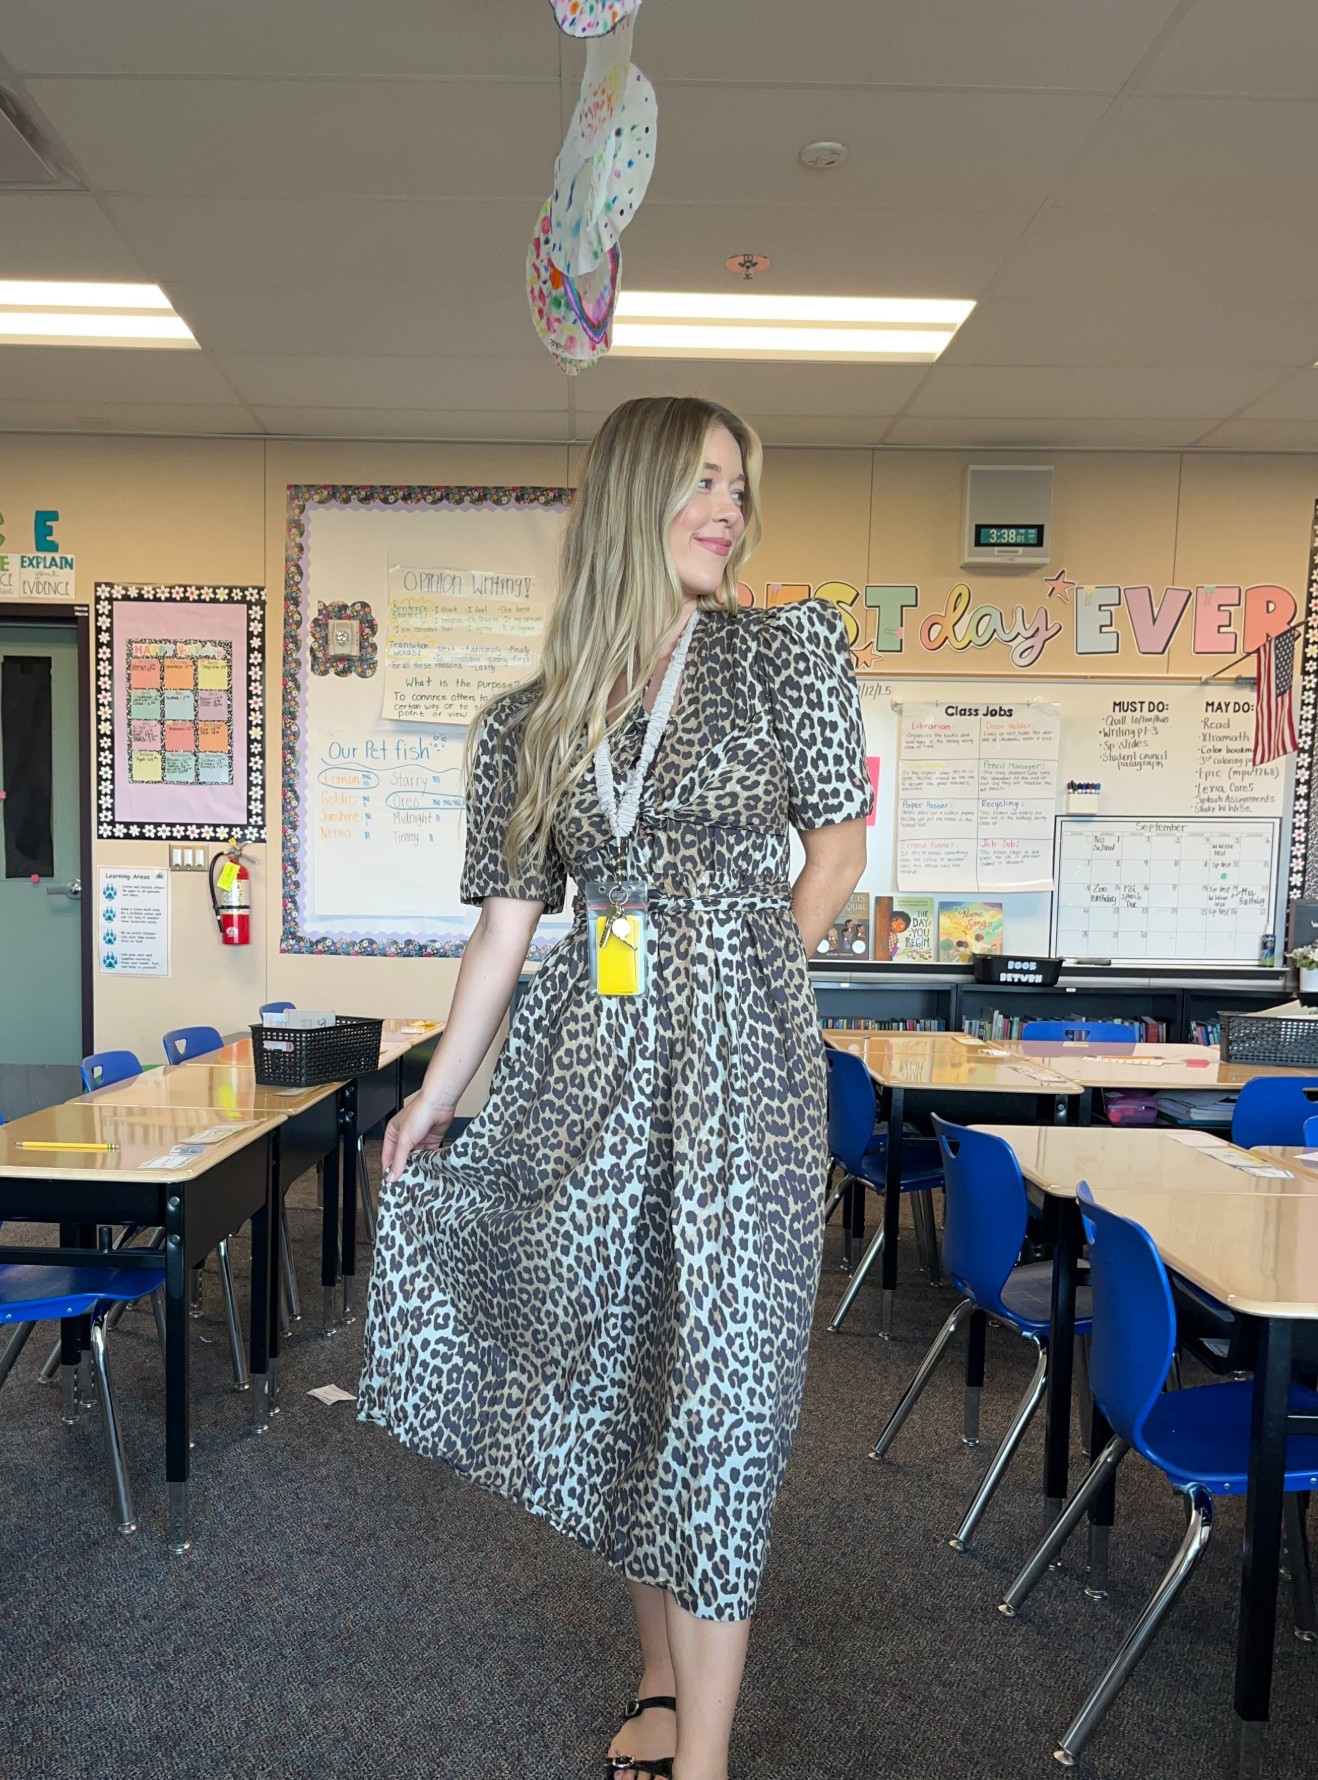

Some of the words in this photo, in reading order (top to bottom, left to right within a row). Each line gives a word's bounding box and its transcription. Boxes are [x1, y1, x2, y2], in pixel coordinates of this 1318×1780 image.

[989, 528, 1016, 543] 3:38
[20, 555, 74, 570] EXPLAIN
[22, 579, 70, 596] EVIDENCE
[472, 573, 532, 599] Writing!
[919, 582, 1062, 669] day
[1075, 584, 1300, 655] EVER
[389, 640, 429, 649] Transition
[434, 661, 463, 670] reasons
[405, 676, 433, 688] What
[440, 679, 449, 687] is
[456, 678, 472, 688] the
[393, 691, 406, 701] To
[411, 693, 448, 702] convince
[450, 692, 476, 702] others
[480, 692, 489, 701] to
[424, 703, 440, 712] way
[944, 705, 979, 717] Class
[982, 706, 1013, 718] Jobs
[1112, 700, 1146, 713] MUST
[1148, 700, 1169, 713] DO:
[1205, 701, 1231, 713] MAY
[1233, 701, 1255, 713] DO:
[398, 710, 425, 719] point
[1203, 717, 1231, 730] Read
[1103, 727, 1136, 739] Writing
[328, 741, 358, 760] Our
[365, 739, 387, 760] Pet
[396, 737, 430, 760] fish
[1104, 740, 1115, 753] Sp
[1118, 739, 1149, 750] slides
[1200, 745, 1223, 755] Color
[1226, 745, 1252, 754] bookm
[1102, 752, 1137, 762] Student
[1139, 750, 1168, 761] council
[983, 760, 1005, 770] Pencil
[1117, 760, 1164, 772] paragraph
[1198, 767, 1222, 782] Epic
[390, 770, 428, 797] Starry
[393, 793, 420, 809] Oreo
[902, 800, 923, 810] Paper
[1194, 805, 1216, 814] Study
[393, 811, 433, 827] Midnight
[320, 826, 352, 841] Nemo
[1136, 822, 1188, 833] September
[393, 830, 420, 847] Timmy
[981, 839, 997, 848] Job
[1093, 844, 1116, 852] School
[105, 873, 131, 881] Learning
[133, 873, 151, 881] Areas
[857, 894, 865, 902] IS
[1126, 900, 1138, 908] Due
[845, 903, 867, 911] QUAL
[957, 908, 985, 919] Name
[912, 918, 929, 928] DAY
[965, 918, 992, 930] Song
[911, 928, 930, 938] YOU
[1007, 960, 1037, 971] BOOK
[999, 972, 1043, 984] RETURN
